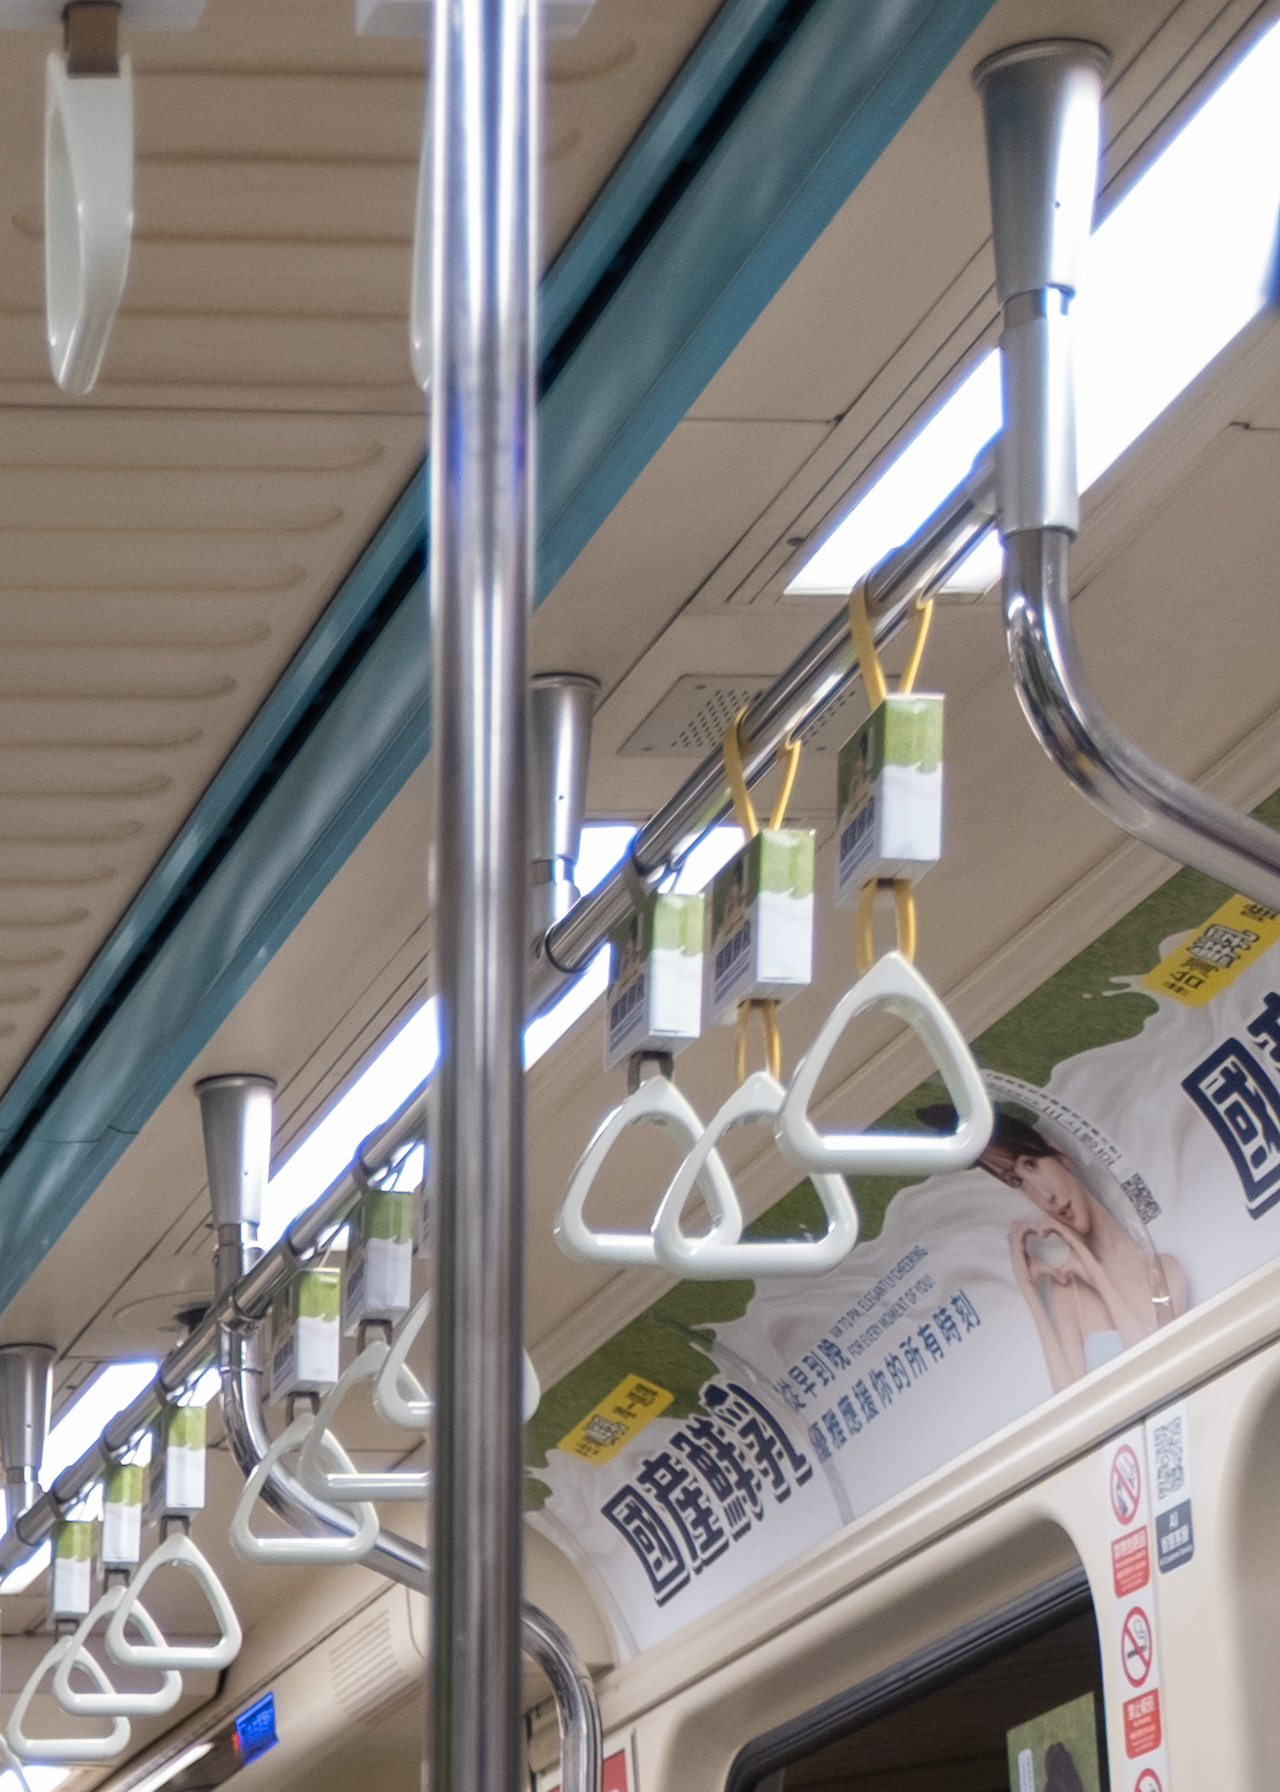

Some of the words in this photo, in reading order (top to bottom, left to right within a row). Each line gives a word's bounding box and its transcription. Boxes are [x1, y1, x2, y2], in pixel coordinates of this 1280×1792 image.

[772, 1338, 851, 1411] 從早到晚
[807, 1289, 981, 1467] 優雅應援你的所有時刻
[601, 1383, 812, 1607] 國產鮮乳
